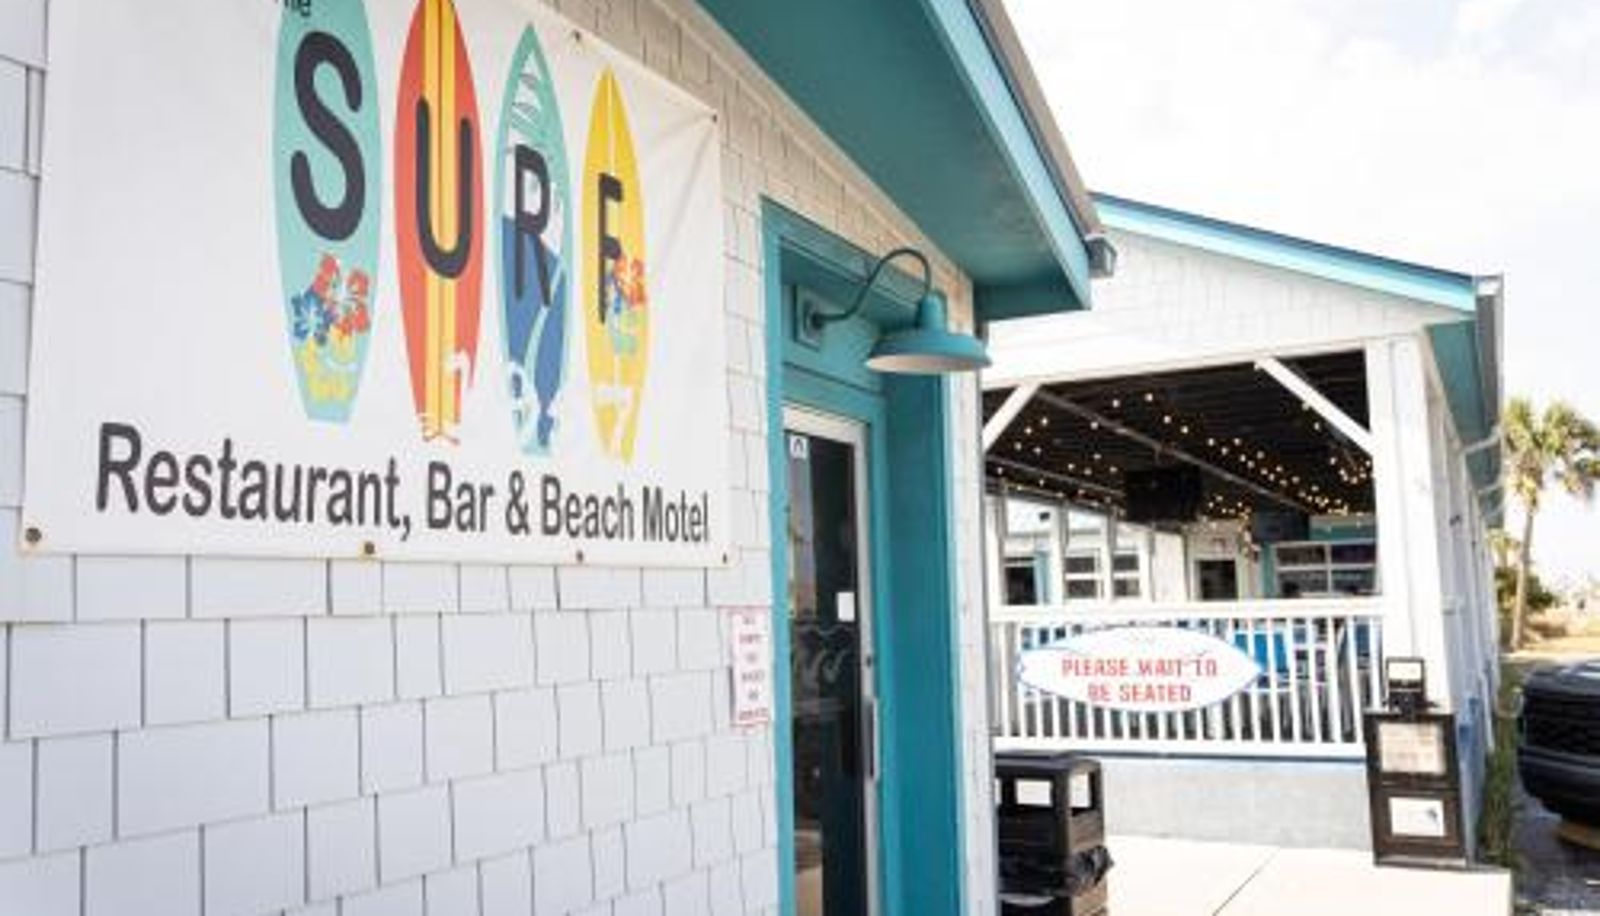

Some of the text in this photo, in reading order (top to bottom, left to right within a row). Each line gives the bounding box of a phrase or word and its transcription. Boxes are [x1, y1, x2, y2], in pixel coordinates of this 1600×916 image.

[290, 30, 624, 325] SURF
[96, 422, 709, 543] Restaurant, Bar & Beach Motel
[1062, 657, 1217, 677] PLEASE WAIT TO
[1088, 684, 1191, 702] BE SEATED
